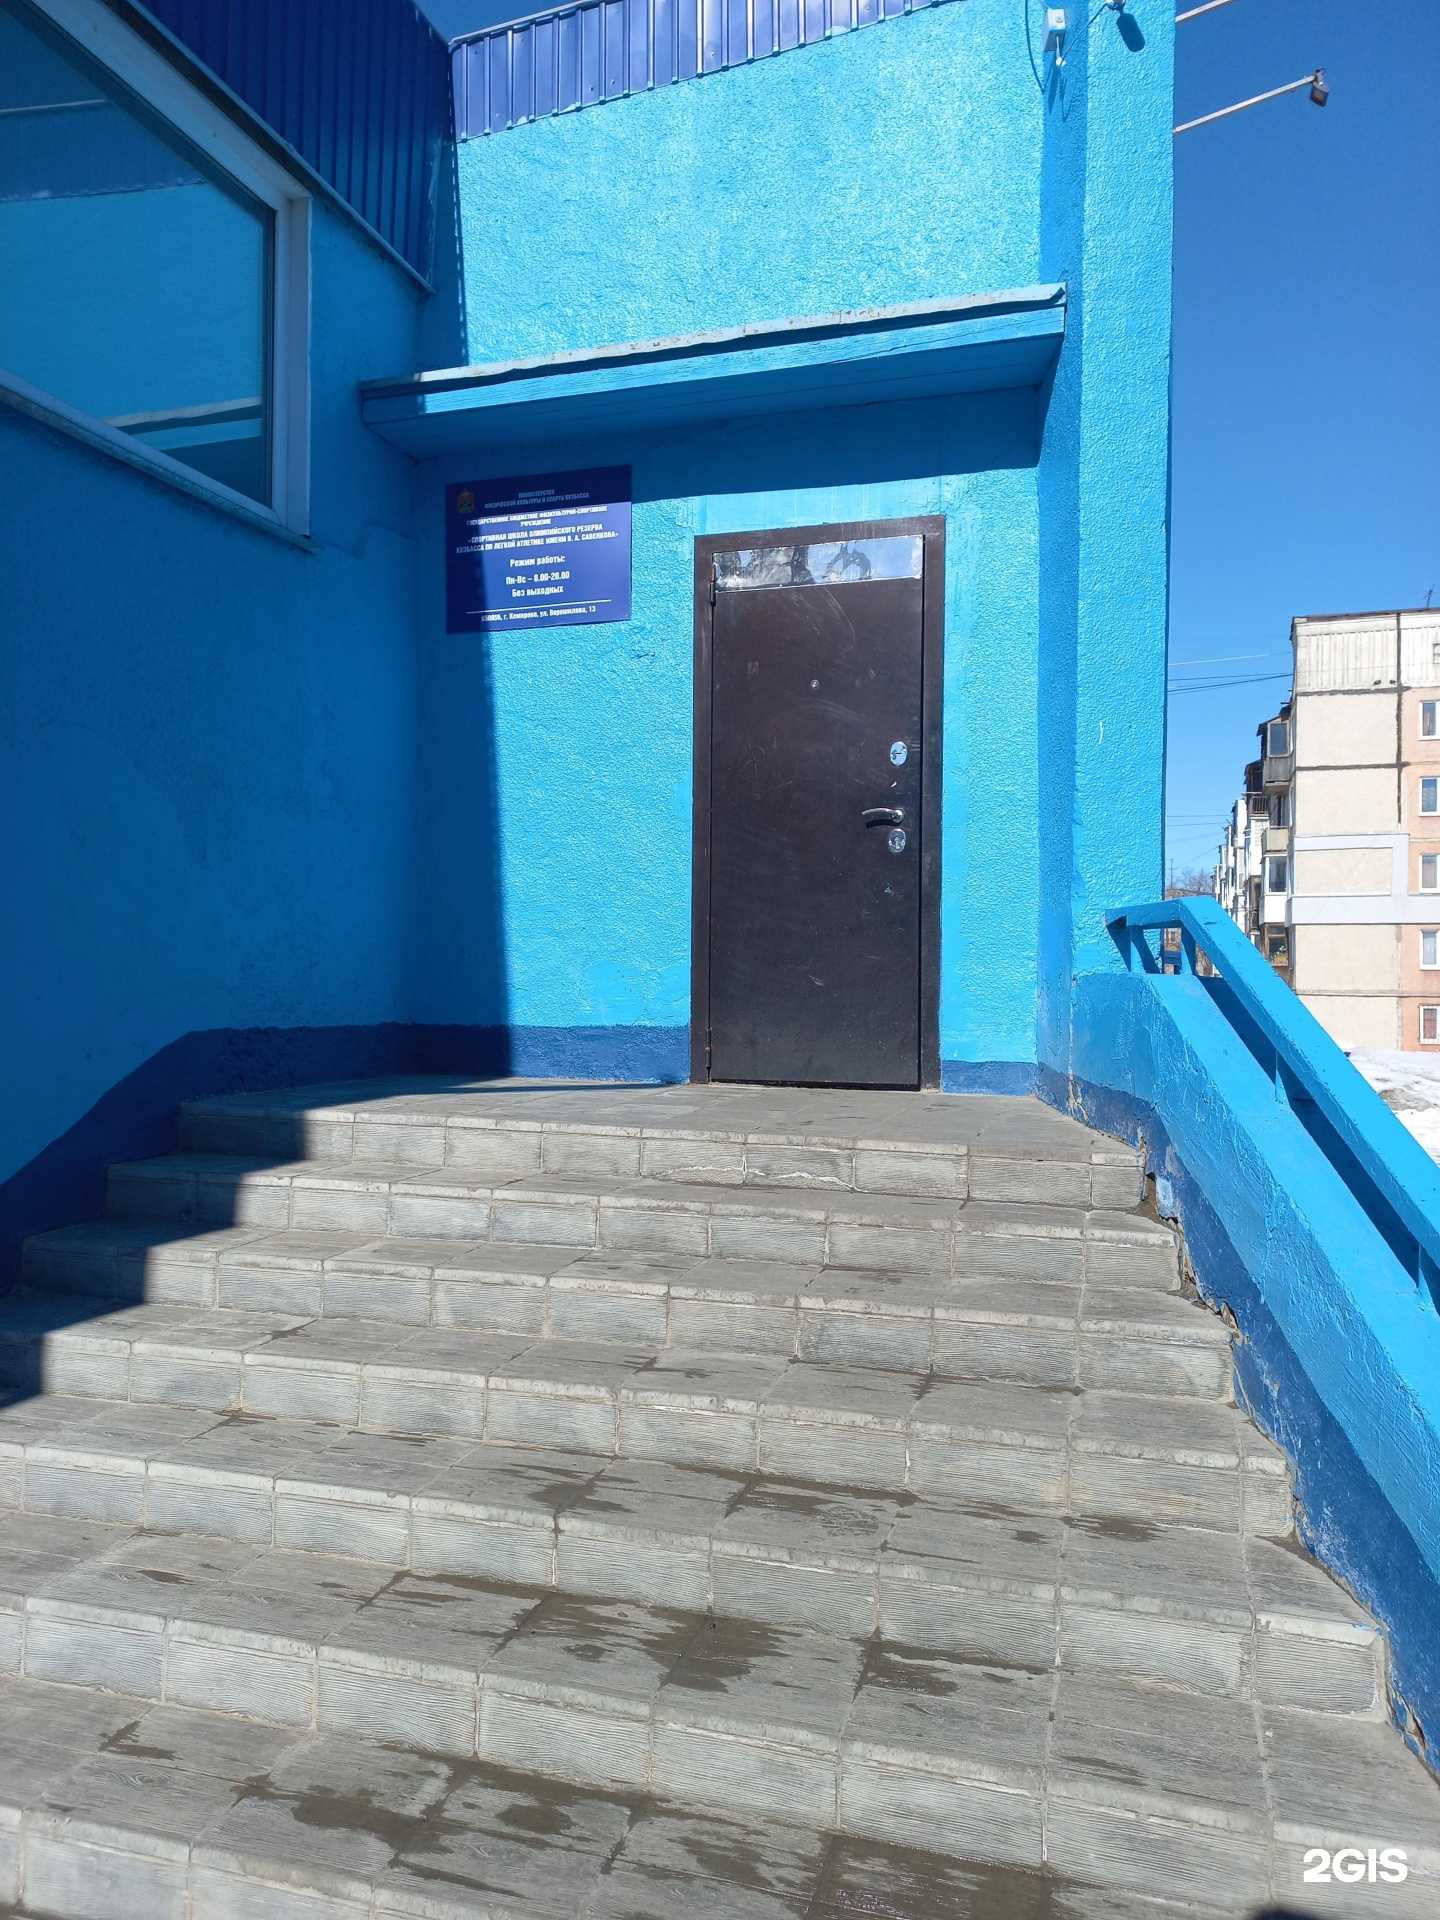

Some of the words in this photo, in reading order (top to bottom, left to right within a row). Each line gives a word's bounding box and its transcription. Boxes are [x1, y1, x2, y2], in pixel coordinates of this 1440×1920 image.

[508, 530, 528, 539] ШКОЛА
[577, 523, 603, 532] РЕЗЕРВА
[517, 538, 544, 547] АТЛЕТИКЕ
[509, 557, 536, 567] Режим
[536, 555, 566, 566] работы:
[506, 575, 526, 584] Пн-Вс
[512, 588, 525, 597] Без
[527, 586, 564, 597] выходных
[509, 611, 539, 620] Кемерово,
